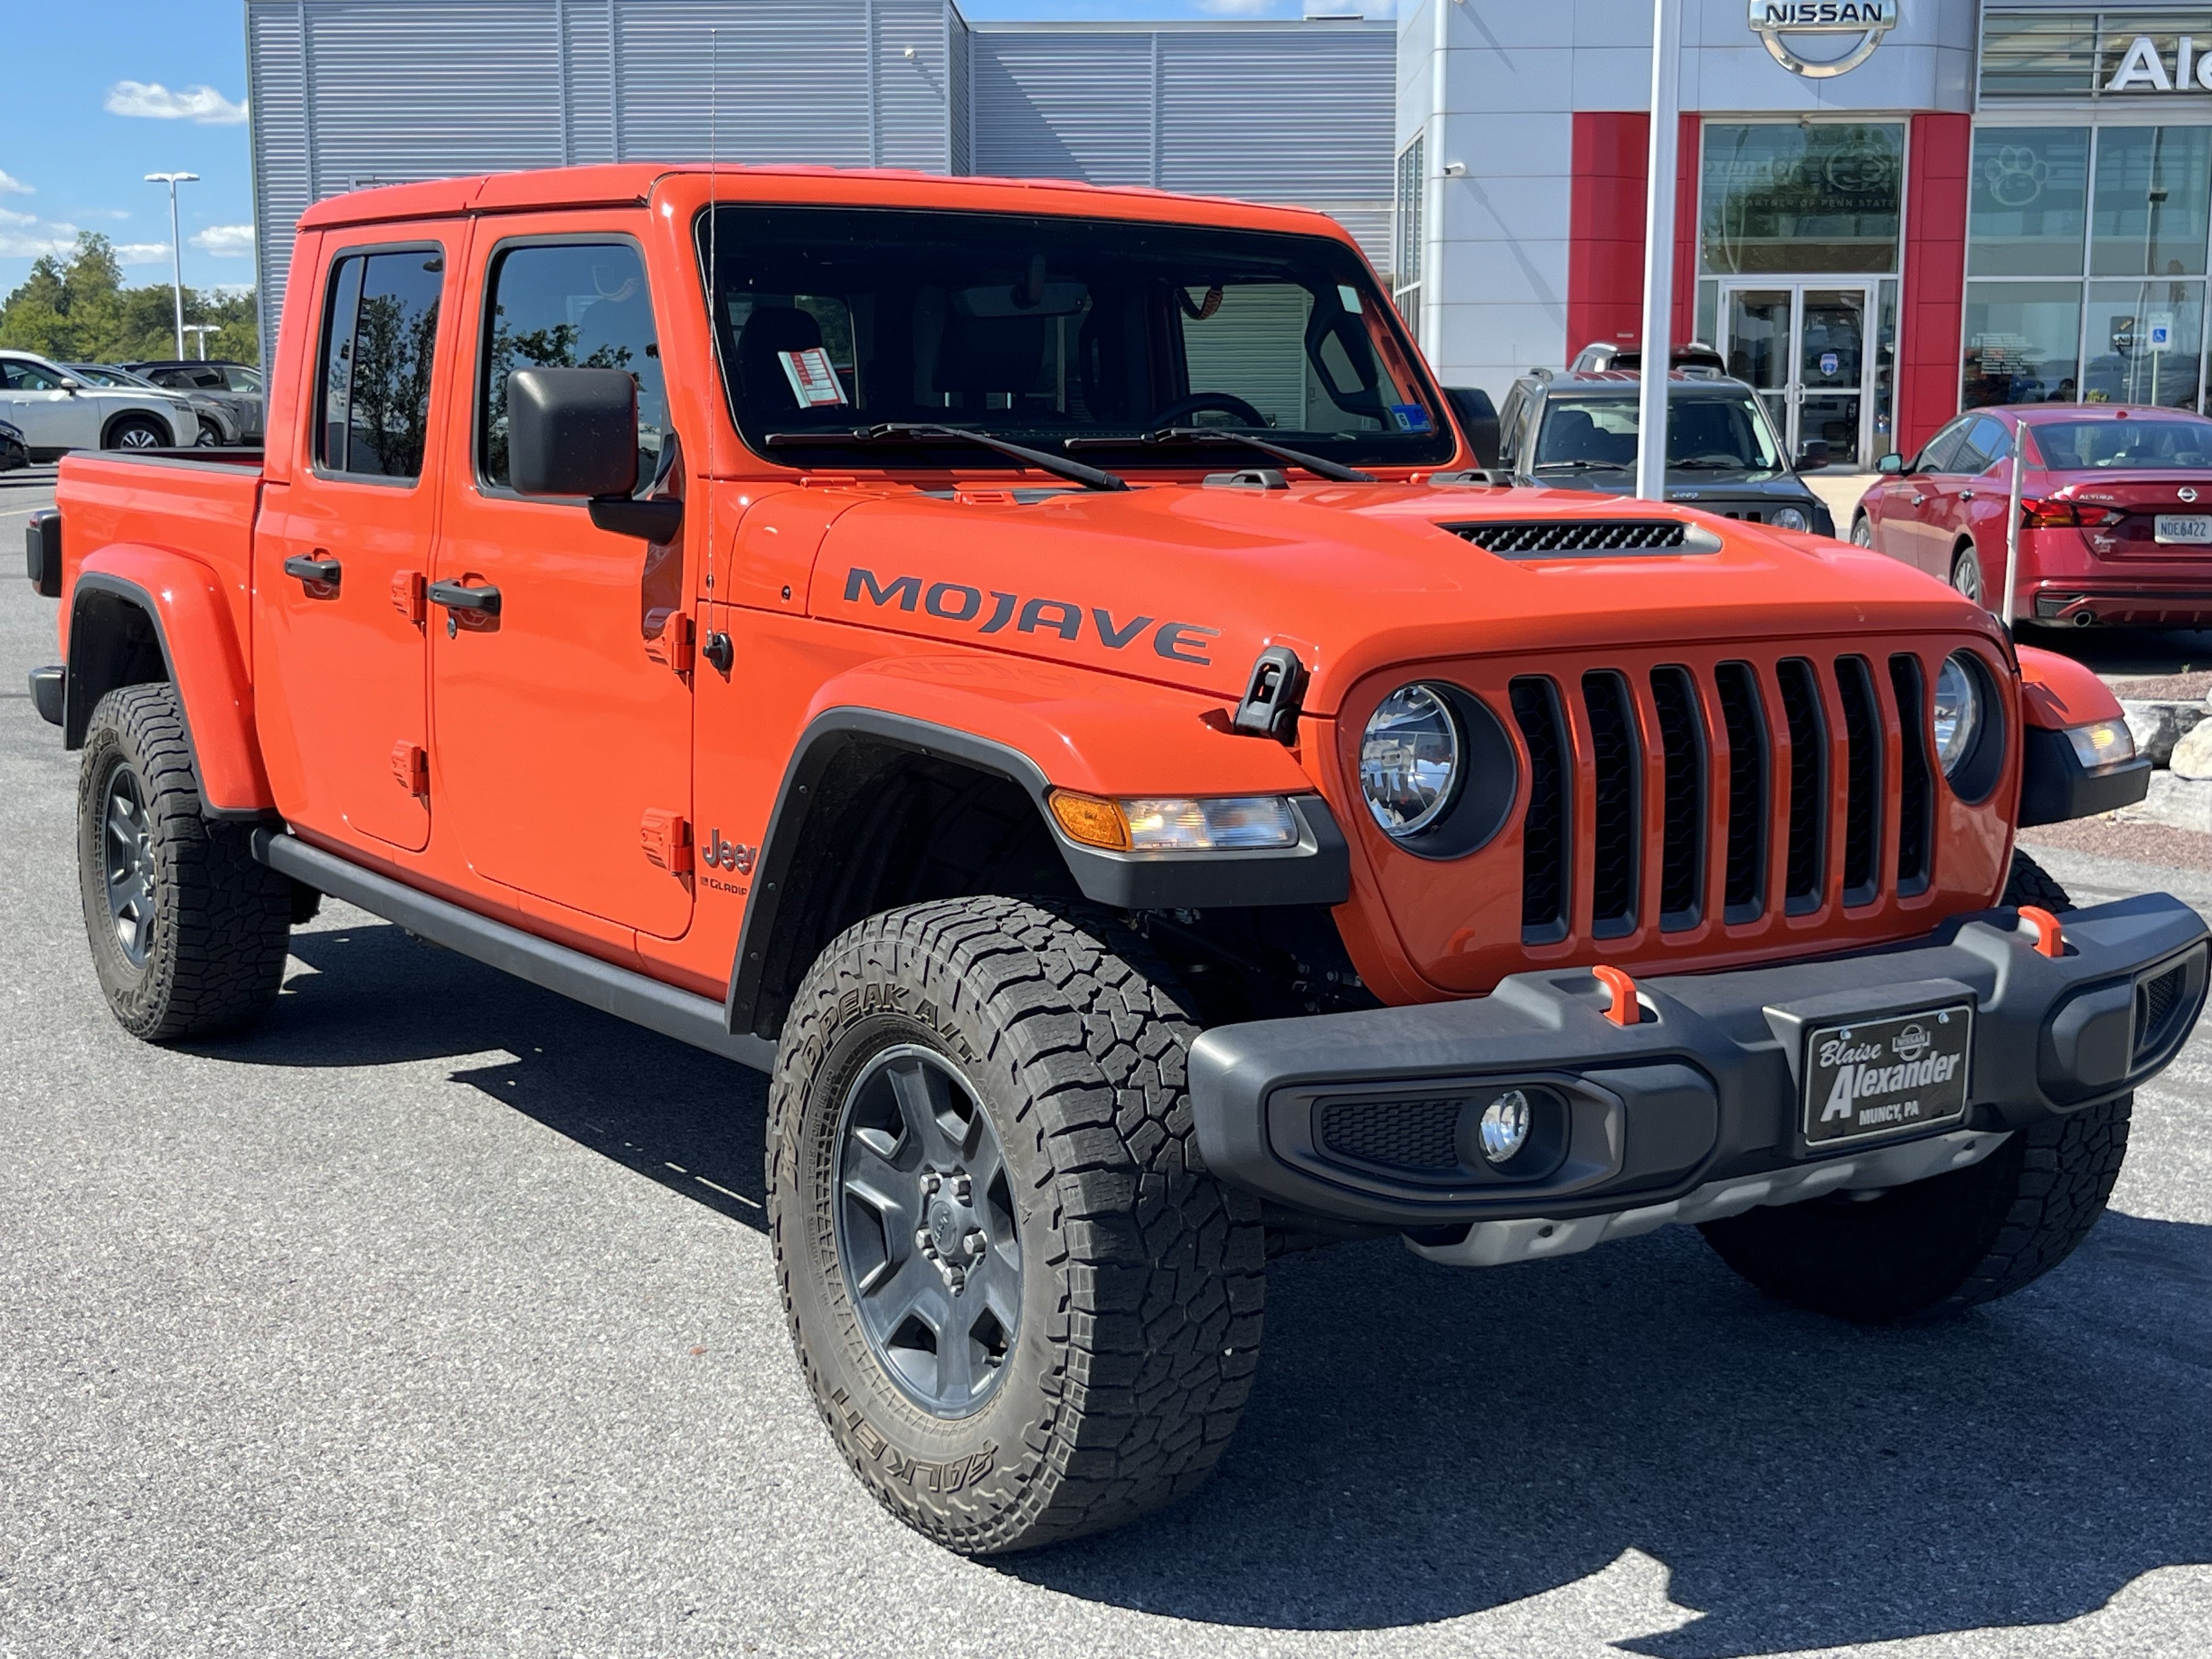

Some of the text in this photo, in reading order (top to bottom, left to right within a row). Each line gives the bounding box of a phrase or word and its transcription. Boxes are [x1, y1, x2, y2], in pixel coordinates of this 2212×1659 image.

[1765, 3, 1882, 22] NISSAN
[1820, 198, 1853, 207] PENN
[1858, 198, 1898, 207] STATE
[844, 567, 1221, 665] MOJAVE
[1819, 1039, 1882, 1068] Blaise
[1896, 1034, 1927, 1047] NISSAN
[1820, 1050, 1961, 1122] Alexander
[1858, 1100, 1920, 1126] MUNCY, PA
